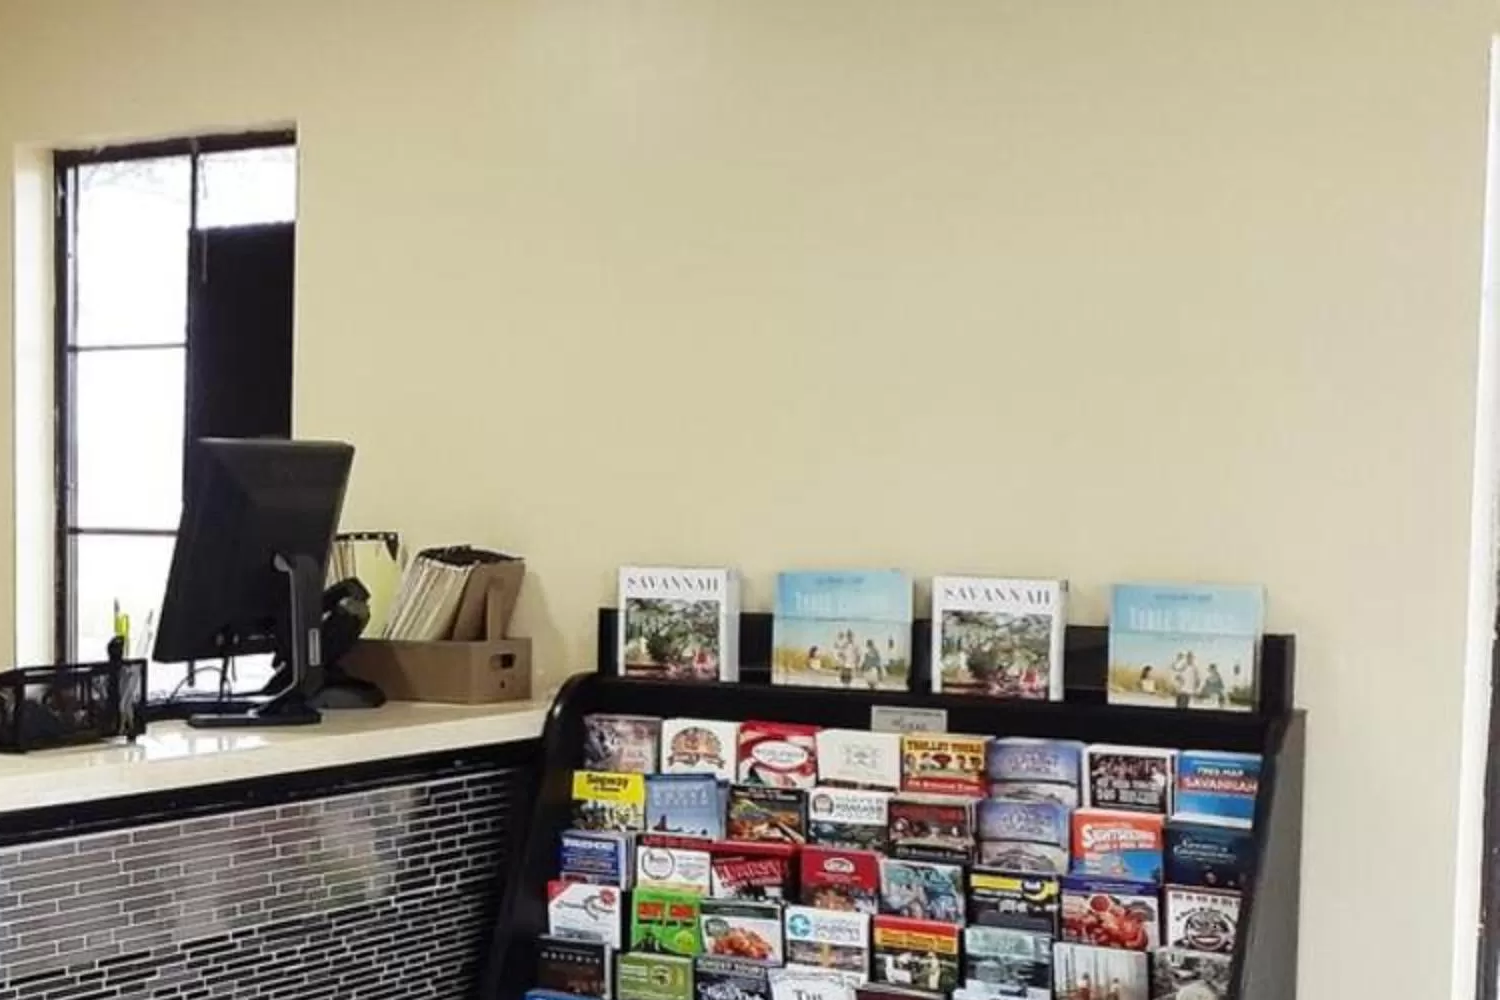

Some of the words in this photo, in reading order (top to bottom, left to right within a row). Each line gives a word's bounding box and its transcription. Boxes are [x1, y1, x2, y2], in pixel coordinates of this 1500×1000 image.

[627, 575, 720, 593] SAVANNAH
[944, 587, 1051, 606] SAVANNAH
[1183, 777, 1260, 795] SAVANNAH
